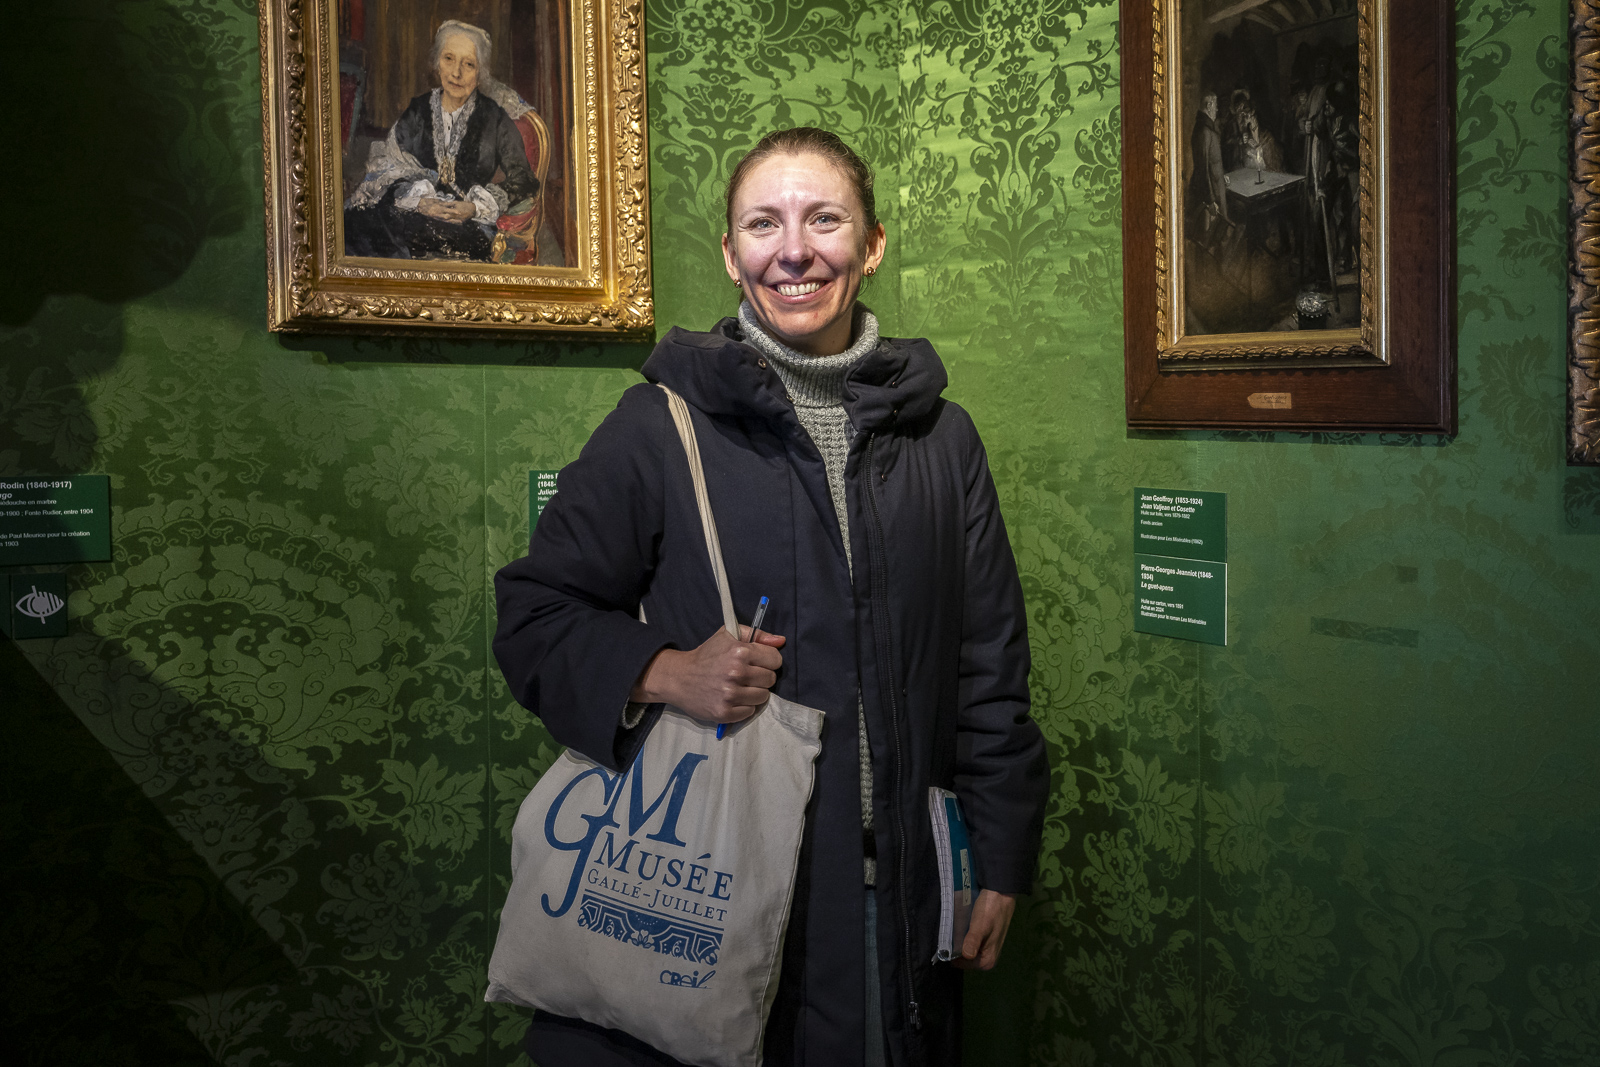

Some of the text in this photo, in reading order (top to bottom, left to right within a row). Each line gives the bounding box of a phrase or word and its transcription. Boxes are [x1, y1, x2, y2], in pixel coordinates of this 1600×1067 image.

[26, 481, 72, 490] (1840-1917)
[1153, 495, 1173, 504] Geoffroy
[1175, 496, 1203, 506] (1853-1924)
[1177, 505, 1195, 513] Cosette
[1141, 564, 1175, 575] Pierre-Georges
[1176, 568, 1197, 577] Jeanniot
[1148, 583, 1174, 592] guet-apens
[594, 831, 733, 901] MUSÉE
[587, 868, 728, 922] GALLÉ-JUILLET
